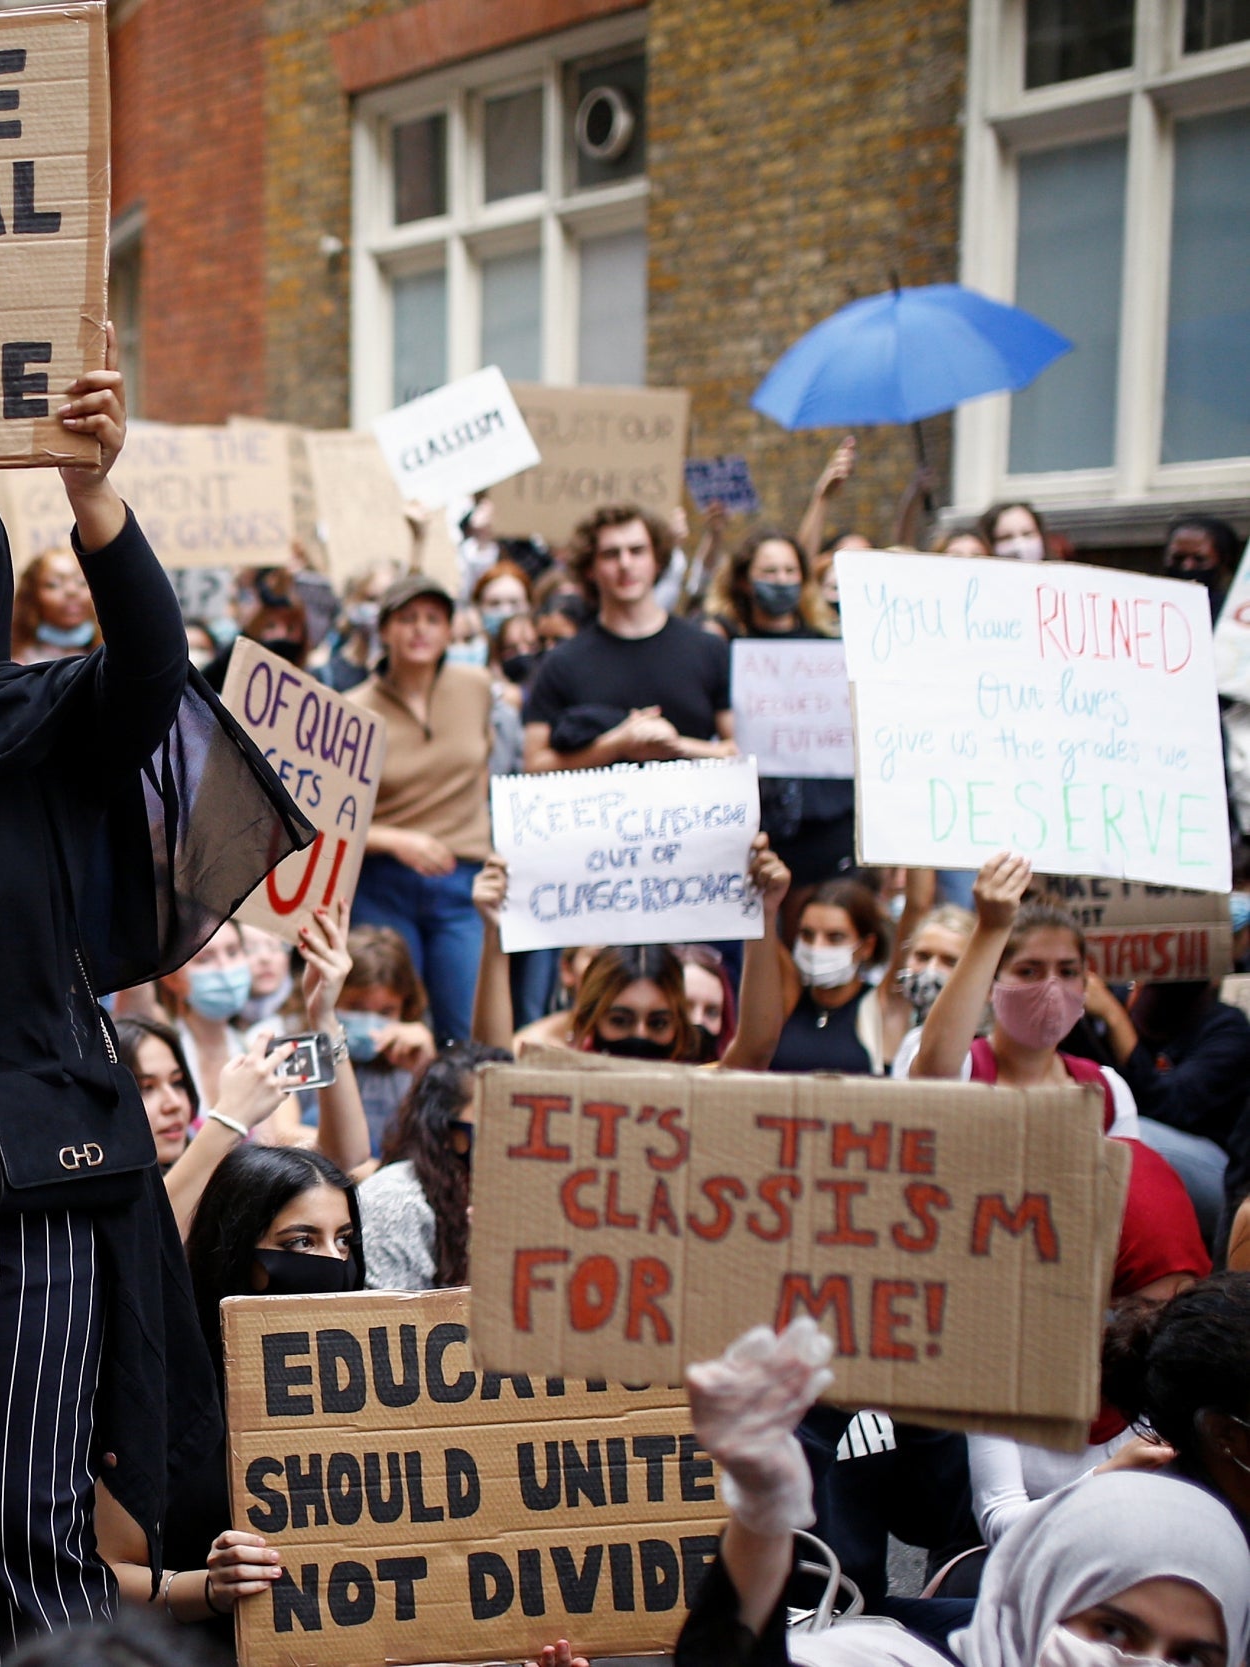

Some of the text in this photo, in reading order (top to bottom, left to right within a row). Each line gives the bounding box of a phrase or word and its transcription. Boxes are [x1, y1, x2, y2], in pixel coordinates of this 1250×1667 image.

[400, 409, 505, 472] CLASSISM
[965, 577, 1023, 642] have
[1036, 583, 1193, 674] RUINED
[874, 723, 935, 784] give
[993, 726, 1046, 761] the
[1058, 728, 1140, 782] grades
[336, 795, 357, 832] A
[509, 790, 627, 846] KEEP
[928, 776, 1212, 868] DESERVE
[586, 843, 682, 872] OUT OF
[507, 1093, 937, 1175] IT'S THE
[559, 1168, 1060, 1264] CLASSISM
[511, 1247, 950, 1362] FOR ME!
[245, 1433, 717, 1534] SHOULD UNITE
[270, 1534, 721, 1634] NOT DIVIDE
